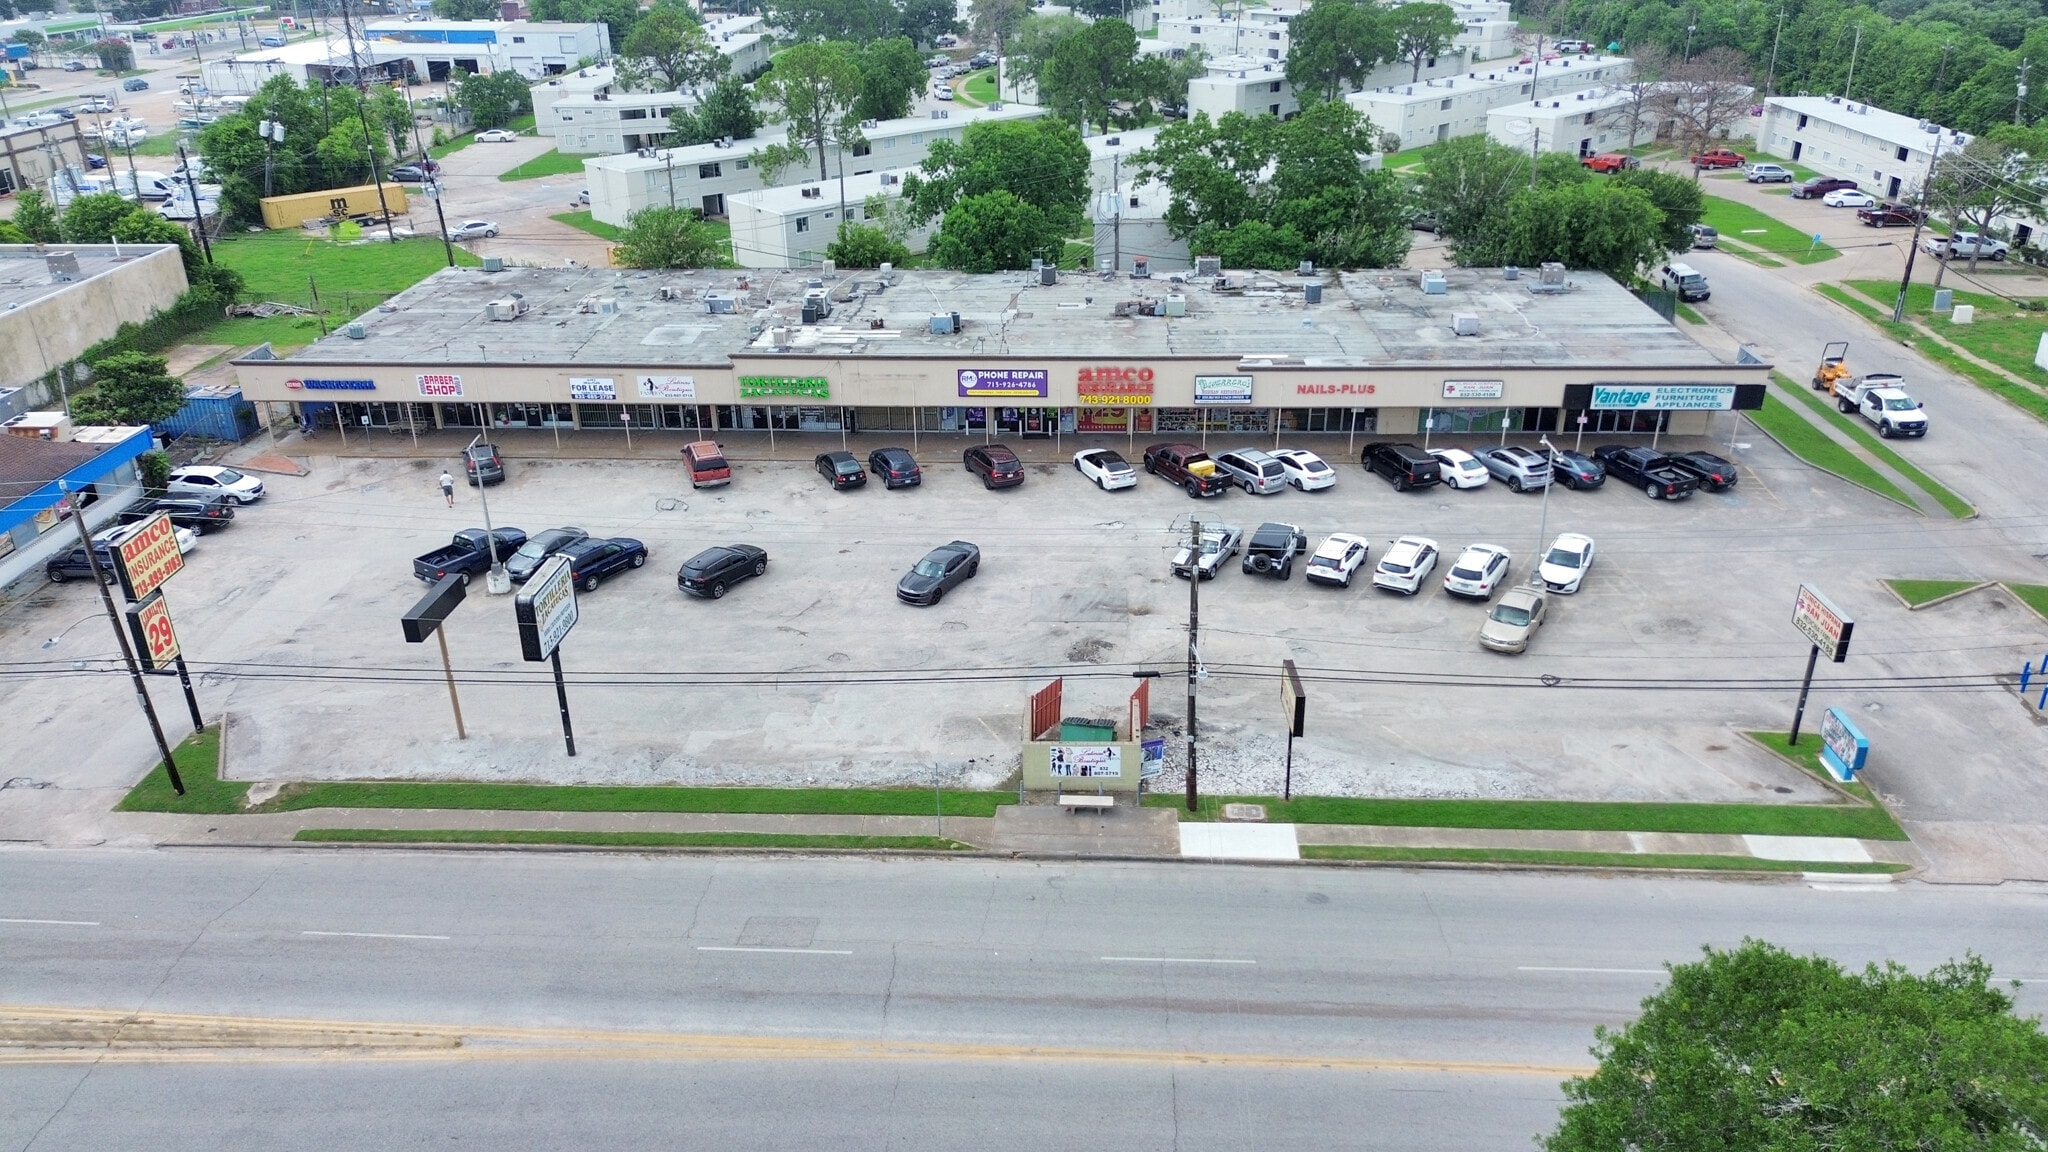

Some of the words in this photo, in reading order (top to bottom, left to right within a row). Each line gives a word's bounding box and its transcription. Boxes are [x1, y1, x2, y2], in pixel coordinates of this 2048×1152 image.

[423, 375, 453, 384] BARBER
[978, 371, 1009, 379] PHONE
[1012, 371, 1044, 379] REPAIR
[1078, 367, 1154, 381] amco
[572, 384, 588, 392] FOR
[589, 384, 613, 392] LEASE
[738, 376, 828, 388] TORTILLERIA
[426, 385, 456, 395] SHOP
[740, 388, 830, 399] ZACATECAS
[1078, 383, 1154, 394] INSURANCE
[1297, 384, 1375, 395] NAILS-PLUS
[1080, 395, 1151, 405] 713-921-8000
[1594, 387, 1650, 407] Vantage
[123, 517, 170, 563] amco
[129, 535, 176, 582] INSURANCE
[535, 570, 571, 617] TORTILLERIA
[541, 585, 569, 625] ZACATECAS
[1802, 590, 1820, 610] CLINICA
[1821, 606, 1841, 630] HISPANA
[1806, 603, 1820, 620] SAN
[1820, 619, 1839, 640] JUAN
